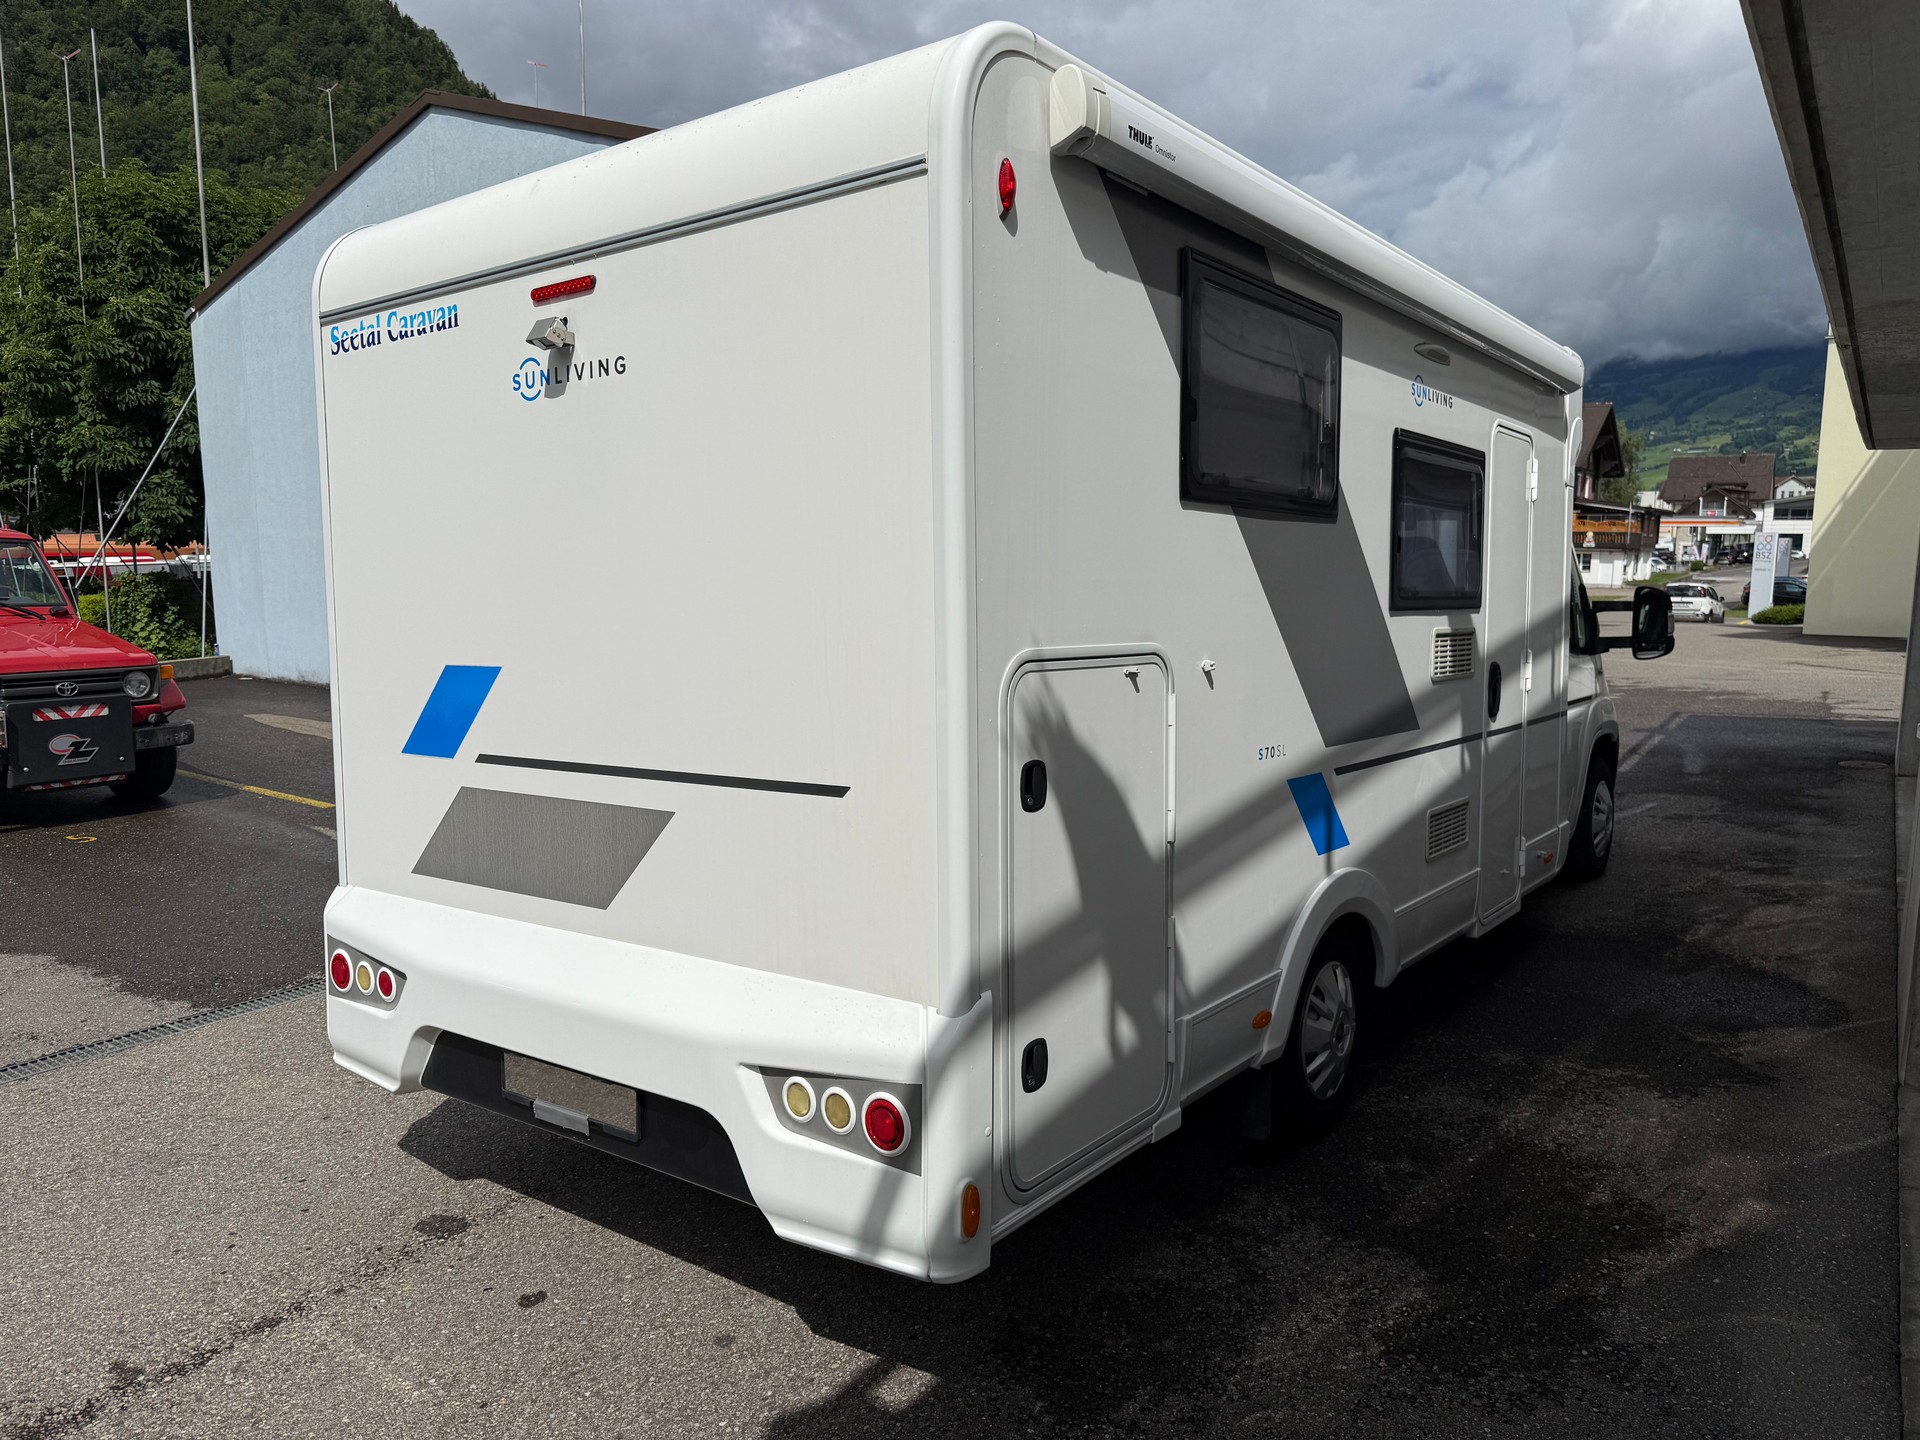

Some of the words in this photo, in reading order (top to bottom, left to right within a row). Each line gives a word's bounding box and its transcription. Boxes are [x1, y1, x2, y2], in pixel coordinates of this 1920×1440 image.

[1128, 124, 1153, 150] THULE
[1155, 144, 1176, 162] Omnistor
[330, 313, 382, 355] Seetal
[386, 303, 459, 342] Caravan
[512, 355, 626, 391] SUNLIVING
[1411, 382, 1453, 409] SUNLIVING
[1755, 551, 1772, 560] BSZ
